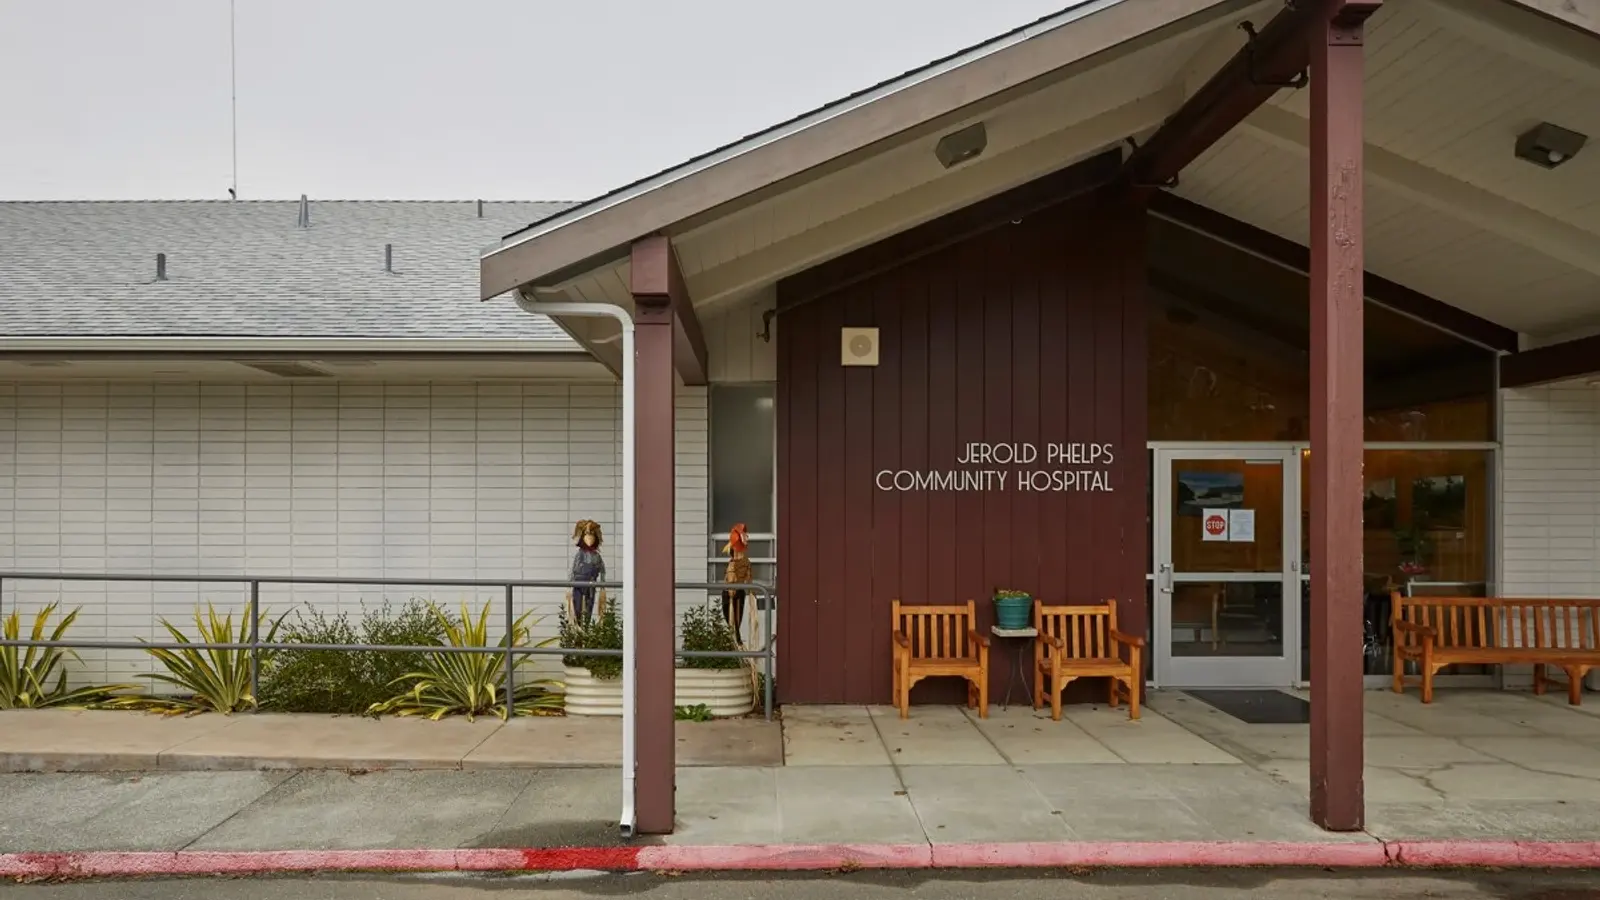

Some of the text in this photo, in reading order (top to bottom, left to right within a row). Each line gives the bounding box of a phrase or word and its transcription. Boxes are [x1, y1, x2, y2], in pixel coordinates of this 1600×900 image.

[957, 443, 1114, 464] JEROLD PHELPS
[876, 470, 1114, 492] COMMUNITY HOSPITAL
[1206, 520, 1225, 530] STOP
